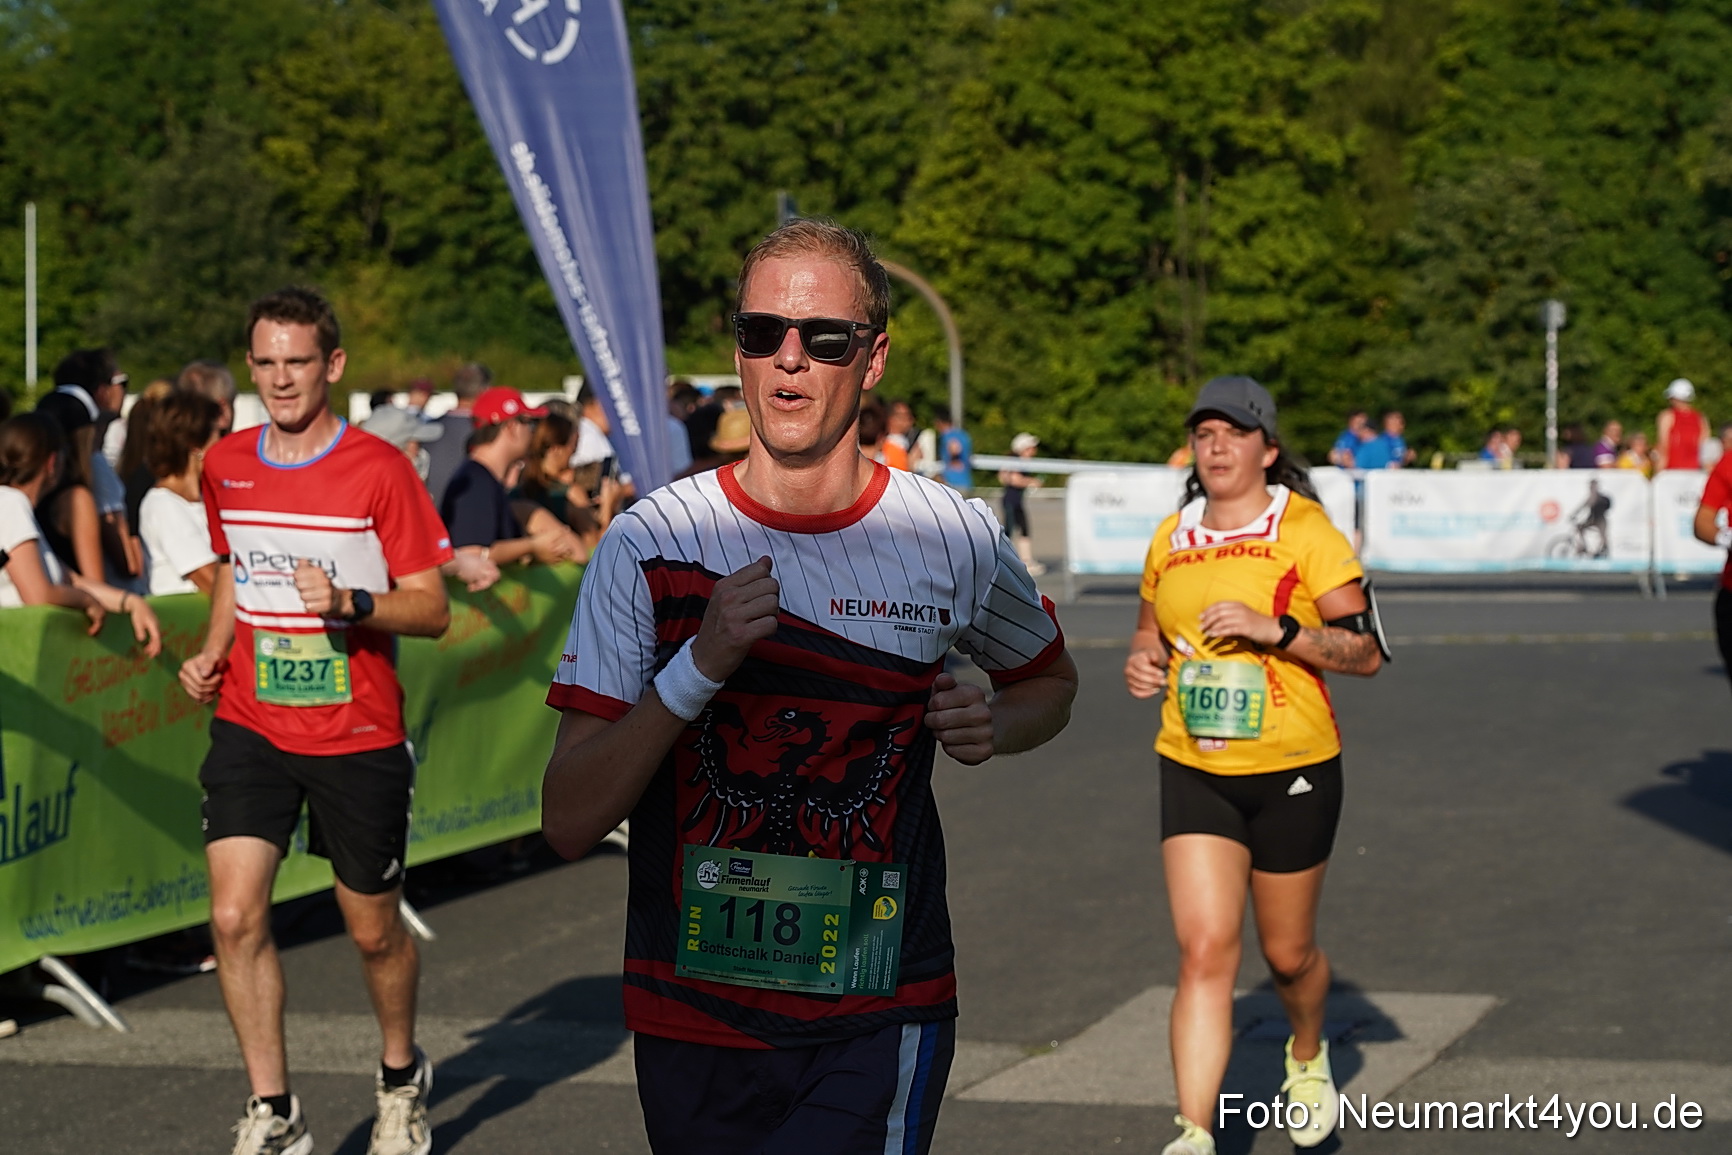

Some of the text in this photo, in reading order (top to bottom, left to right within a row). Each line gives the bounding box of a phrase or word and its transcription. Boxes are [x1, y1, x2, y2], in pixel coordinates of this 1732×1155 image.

[1165, 544, 1276, 571] MAX BÖGL
[830, 598, 935, 622] NEUMARKT
[894, 624, 917, 632] STARKE
[269, 658, 331, 682] 1237
[1189, 686, 1248, 712] 1609
[721, 874, 772, 886] Firmenlauf
[859, 877, 868, 895] AOK
[687, 906, 702, 952] RUN
[719, 896, 802, 946] 118
[700, 940, 820, 966] Gottschalk Daniel
[820, 913, 840, 975] 2022
[746, 967, 773, 976] Neumarkt
[850, 970, 858, 989] Wenn
[858, 968, 867, 989] richtig
